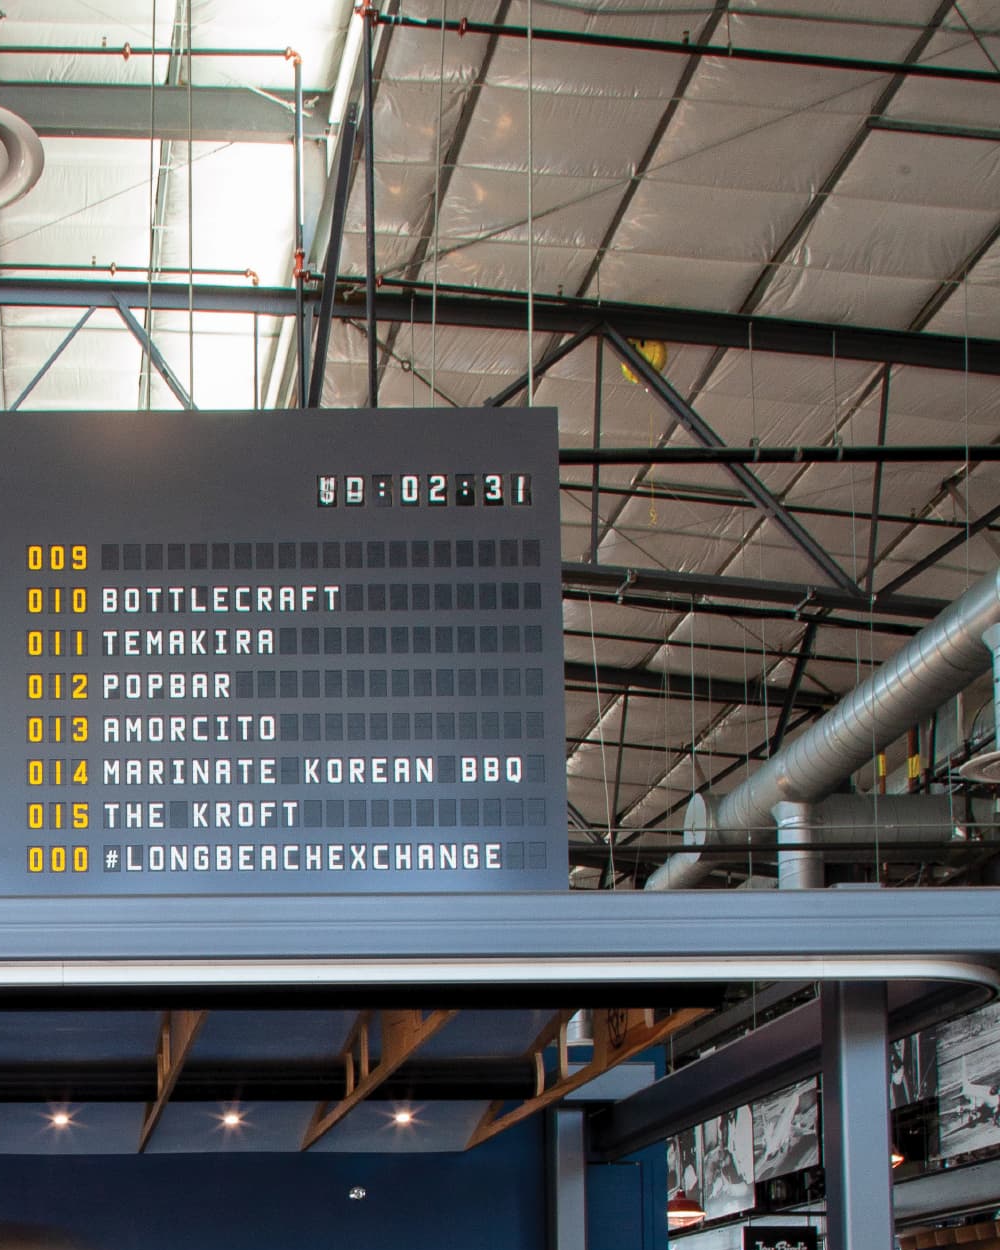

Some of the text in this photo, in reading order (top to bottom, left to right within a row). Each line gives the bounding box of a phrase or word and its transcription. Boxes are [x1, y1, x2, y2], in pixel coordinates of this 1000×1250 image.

[29, 546, 86, 569] 009
[29, 587, 338, 612] 010 BOTTLECRAFT
[29, 630, 272, 655] 011 TEMAKIRA
[29, 674, 229, 698] 012 POPBAR
[29, 716, 274, 742] 013 AMORCITO
[30, 757, 521, 784] 014 MARINATE KOREAN BBQ
[30, 802, 297, 828] 015 THE KROFT
[30, 843, 500, 872] 000 #LONGBEACHEXCHANGE
